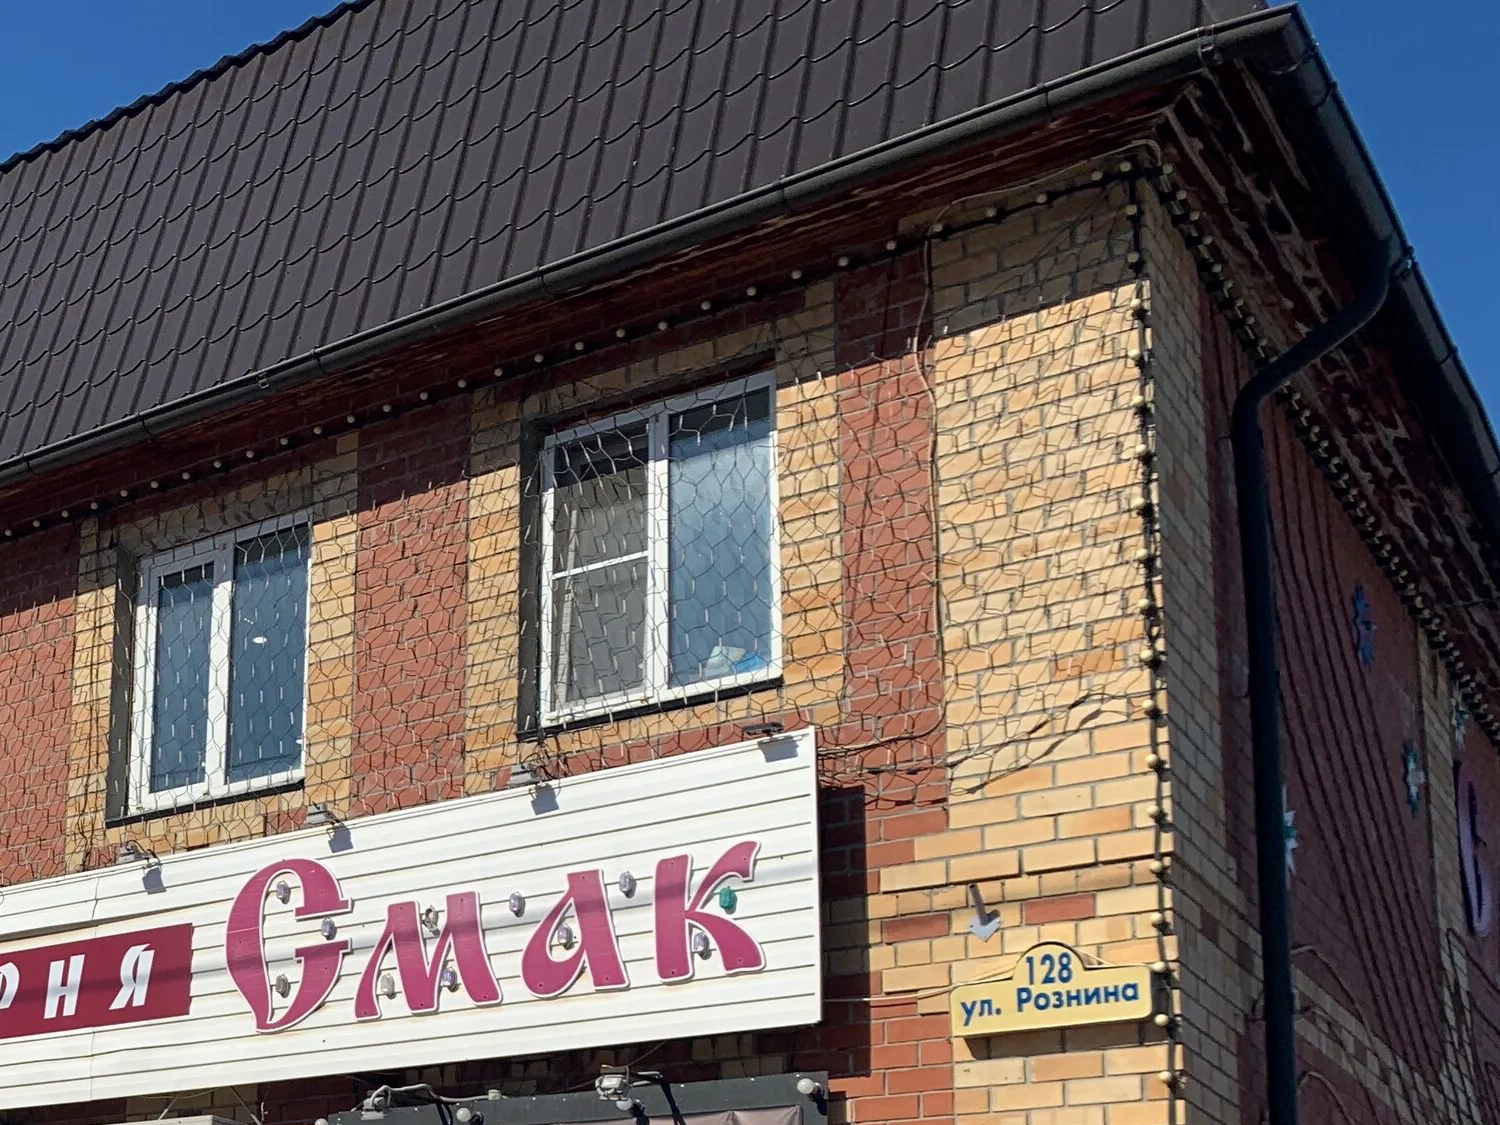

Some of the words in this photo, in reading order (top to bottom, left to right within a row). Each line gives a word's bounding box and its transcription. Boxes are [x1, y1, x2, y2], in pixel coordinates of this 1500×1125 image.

[1026, 952, 1073, 985] 128
[961, 998, 1002, 1027] ул.
[1016, 982, 1140, 1012] Рознина
